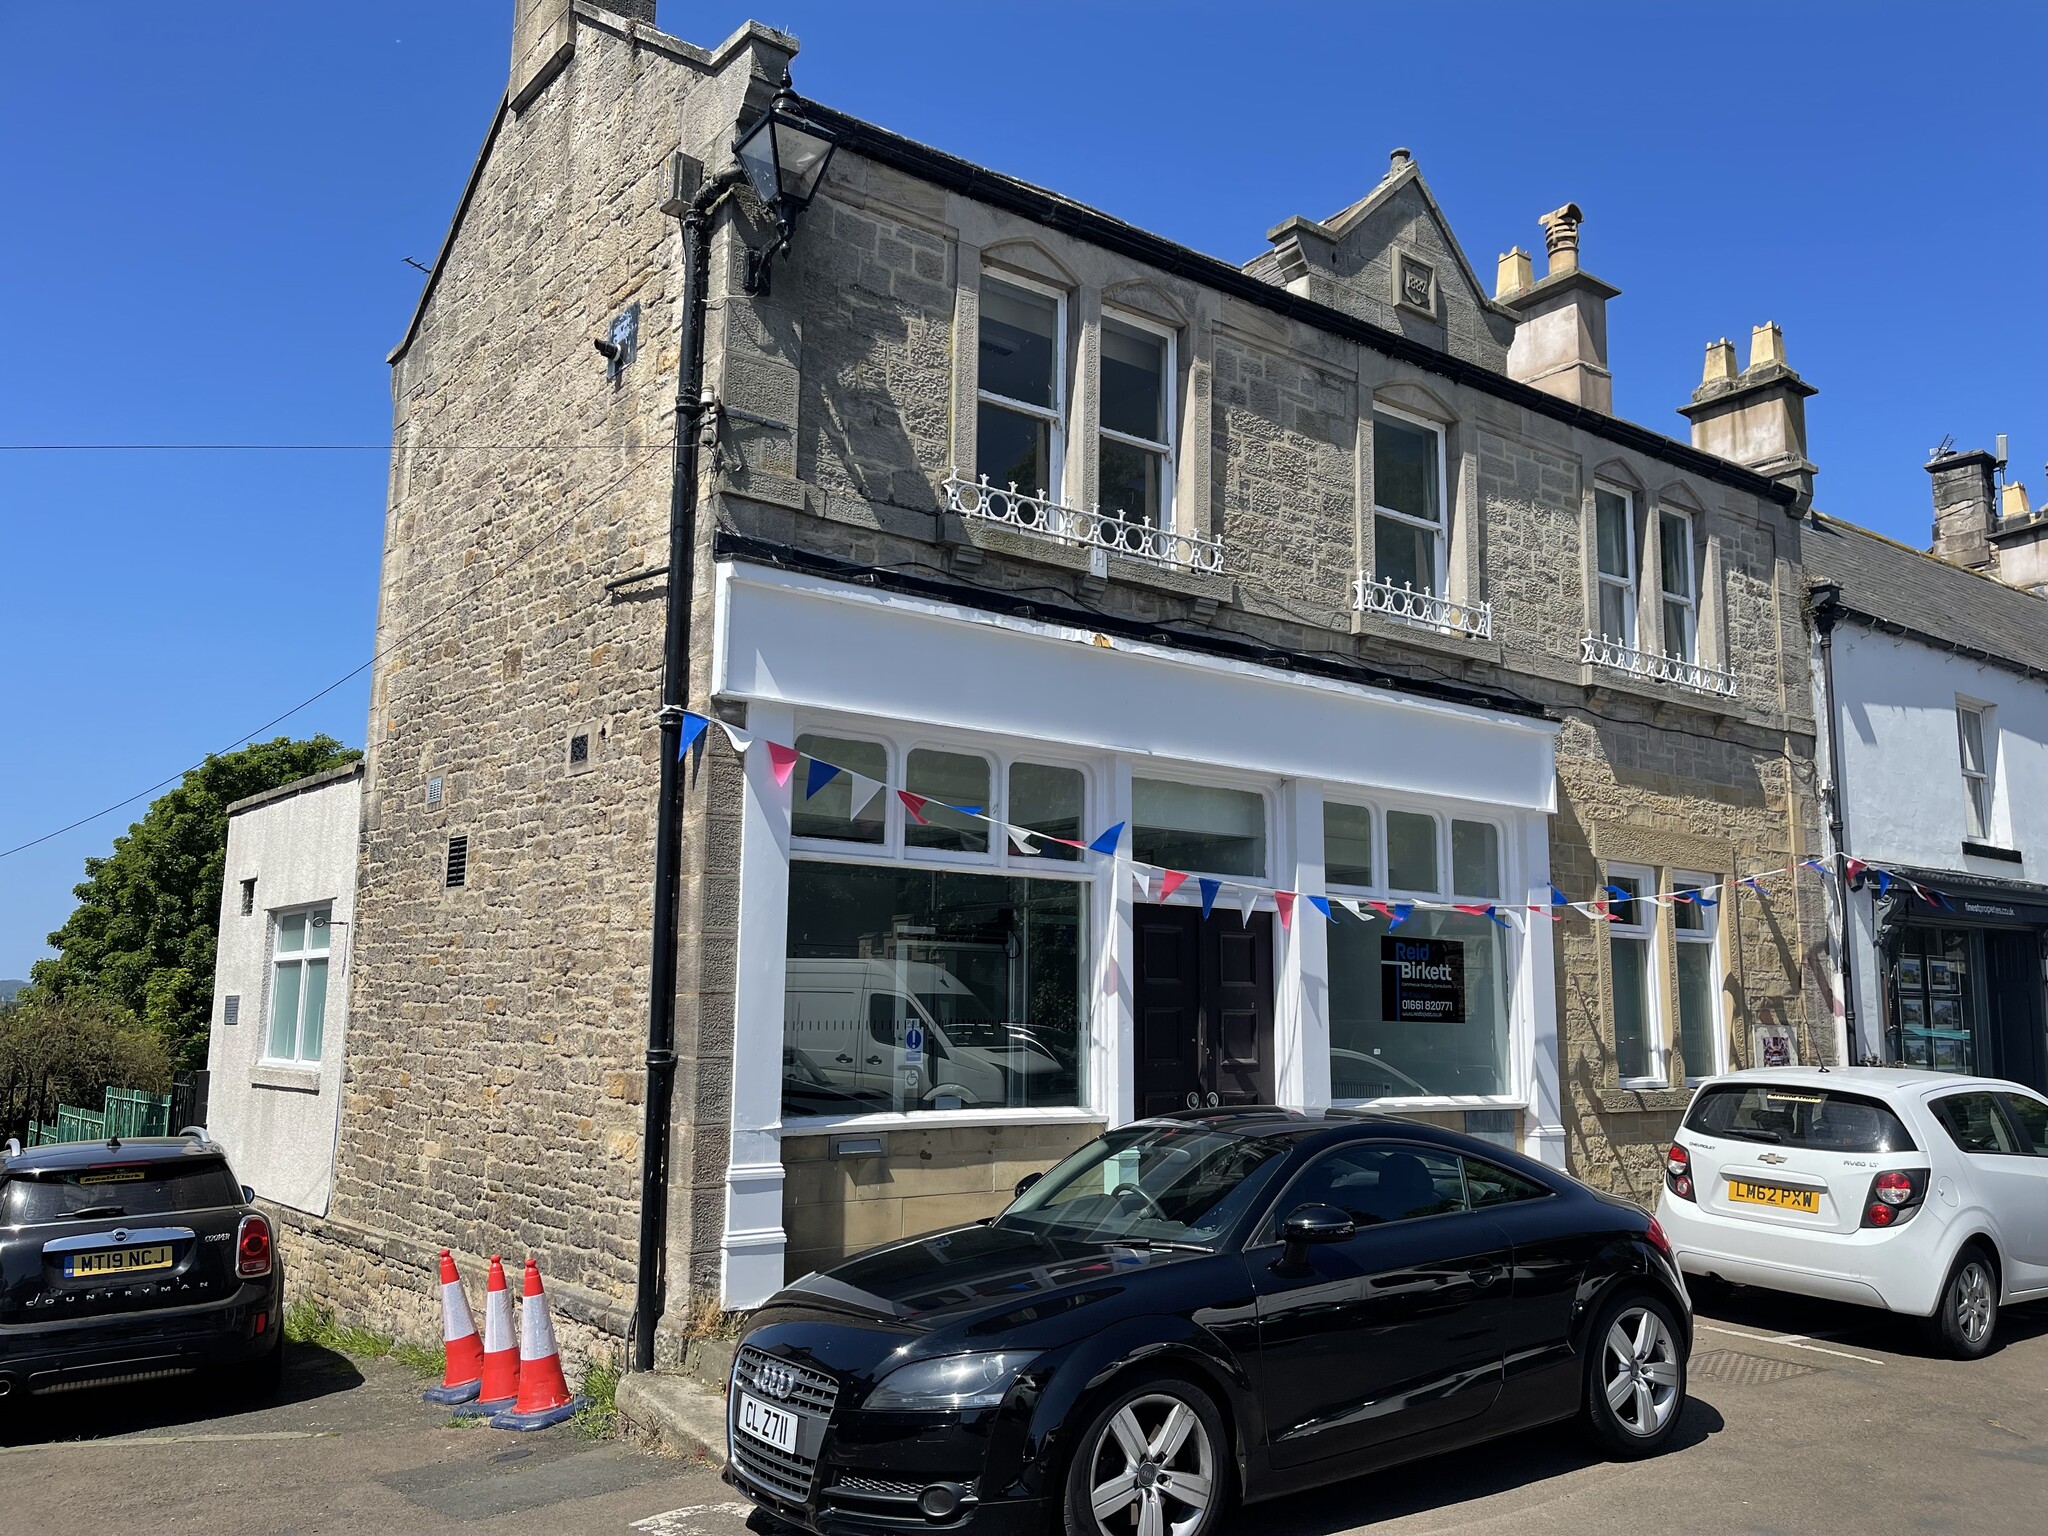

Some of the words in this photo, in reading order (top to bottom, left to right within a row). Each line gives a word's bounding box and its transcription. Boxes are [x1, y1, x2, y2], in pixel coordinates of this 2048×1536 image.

[1395, 942, 1429, 961] Reid
[1401, 961, 1452, 981] Birkett
[1402, 1000, 1424, 1010] 01661
[1424, 1001, 1453, 1011] 820771
[1688, 1141, 1716, 1151] CHEVROLET
[1736, 1182, 1777, 1202] LM62
[1780, 1188, 1812, 1207] PXW
[204, 1232, 231, 1243] COOPER
[81, 1252, 123, 1272] MT19
[129, 1248, 165, 1267] NCJ
[25, 1281, 208, 1307] COUNTRYMAN
